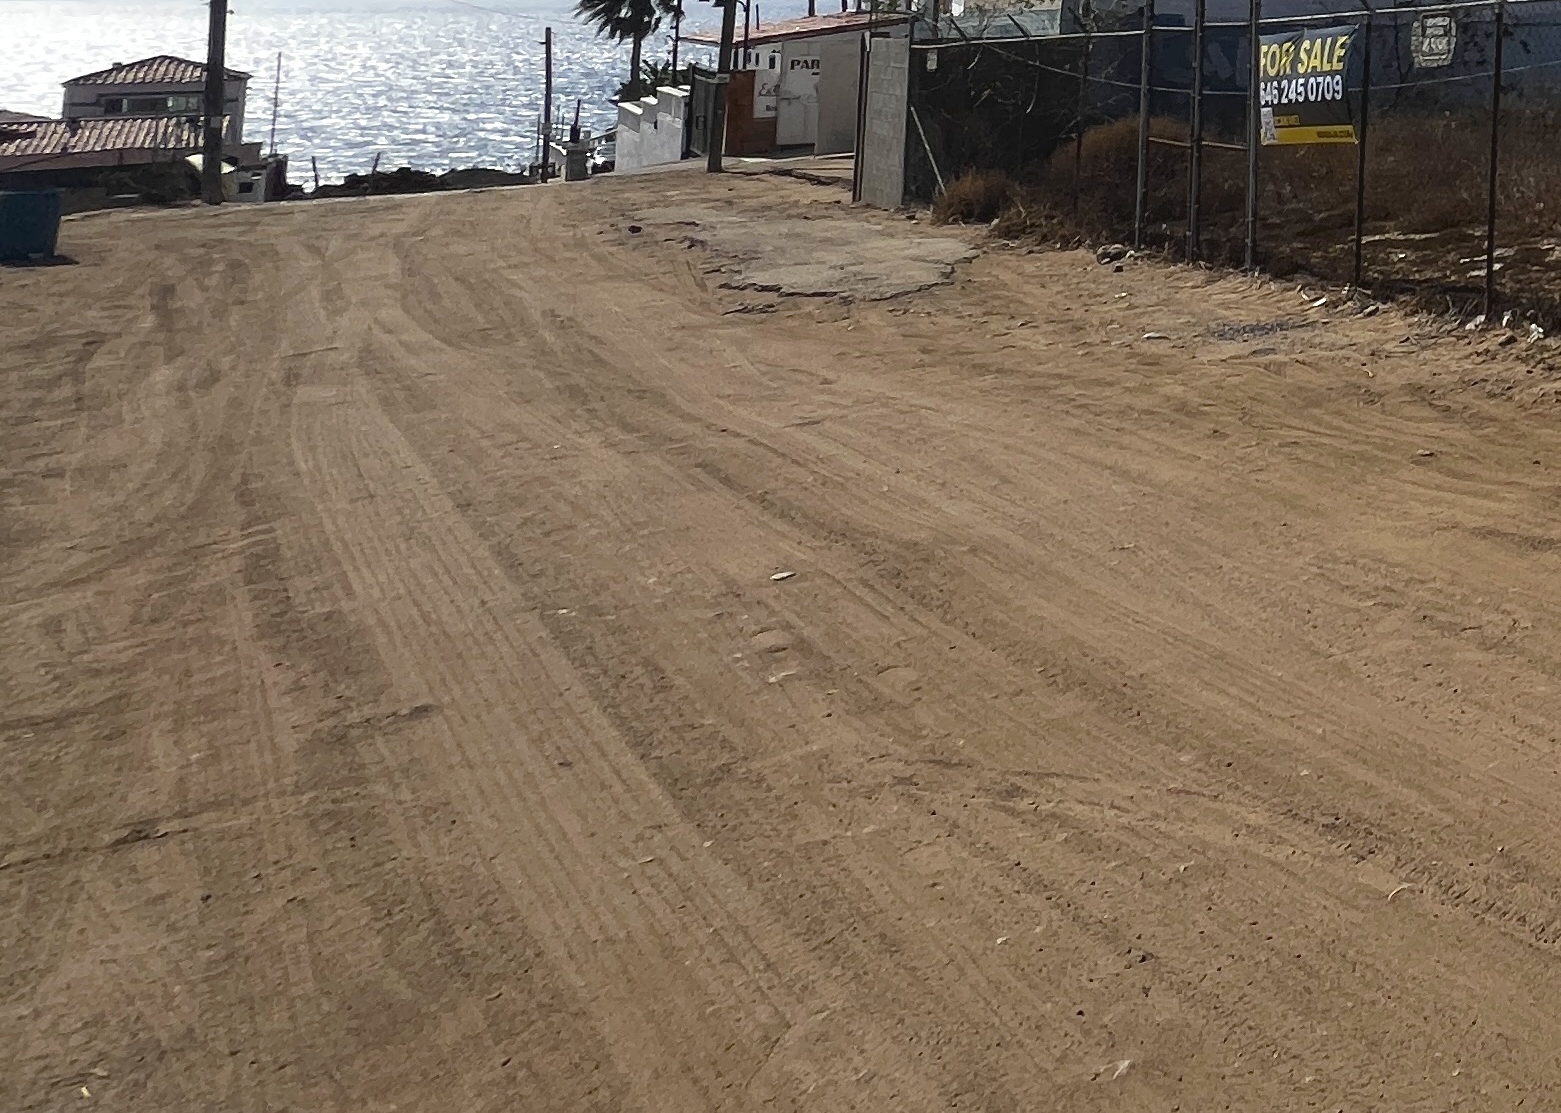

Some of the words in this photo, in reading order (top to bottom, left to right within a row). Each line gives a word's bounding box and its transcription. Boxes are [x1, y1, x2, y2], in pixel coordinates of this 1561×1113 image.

[1260, 41, 1296, 78] FOR
[1297, 34, 1350, 74] SALE
[1280, 77, 1306, 104] 245
[1307, 74, 1343, 102] 0709
